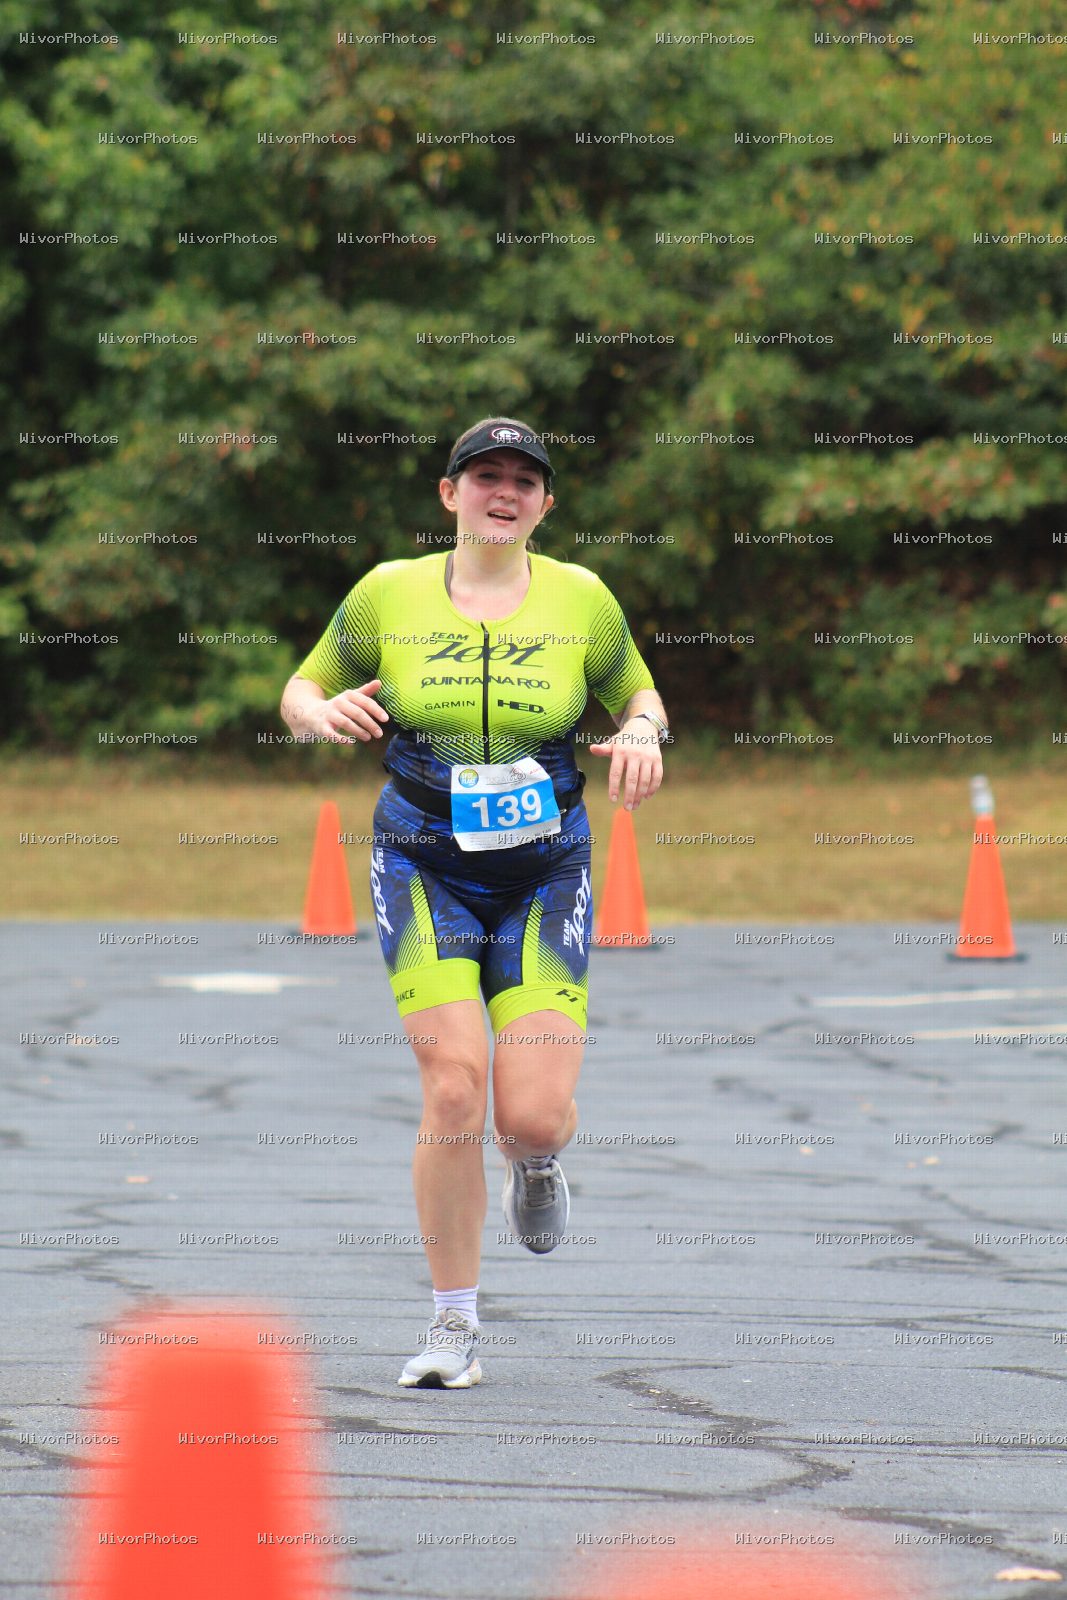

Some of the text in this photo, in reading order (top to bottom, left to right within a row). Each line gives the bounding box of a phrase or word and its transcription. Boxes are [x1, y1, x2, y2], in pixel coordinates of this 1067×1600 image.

[432, 632, 469, 641] TEAM
[517, 678, 550, 690] ROO
[424, 700, 476, 711] GARMIN
[472, 788, 542, 828] 139
[378, 847, 386, 874] TEAM
[563, 919, 571, 946] TEAM
